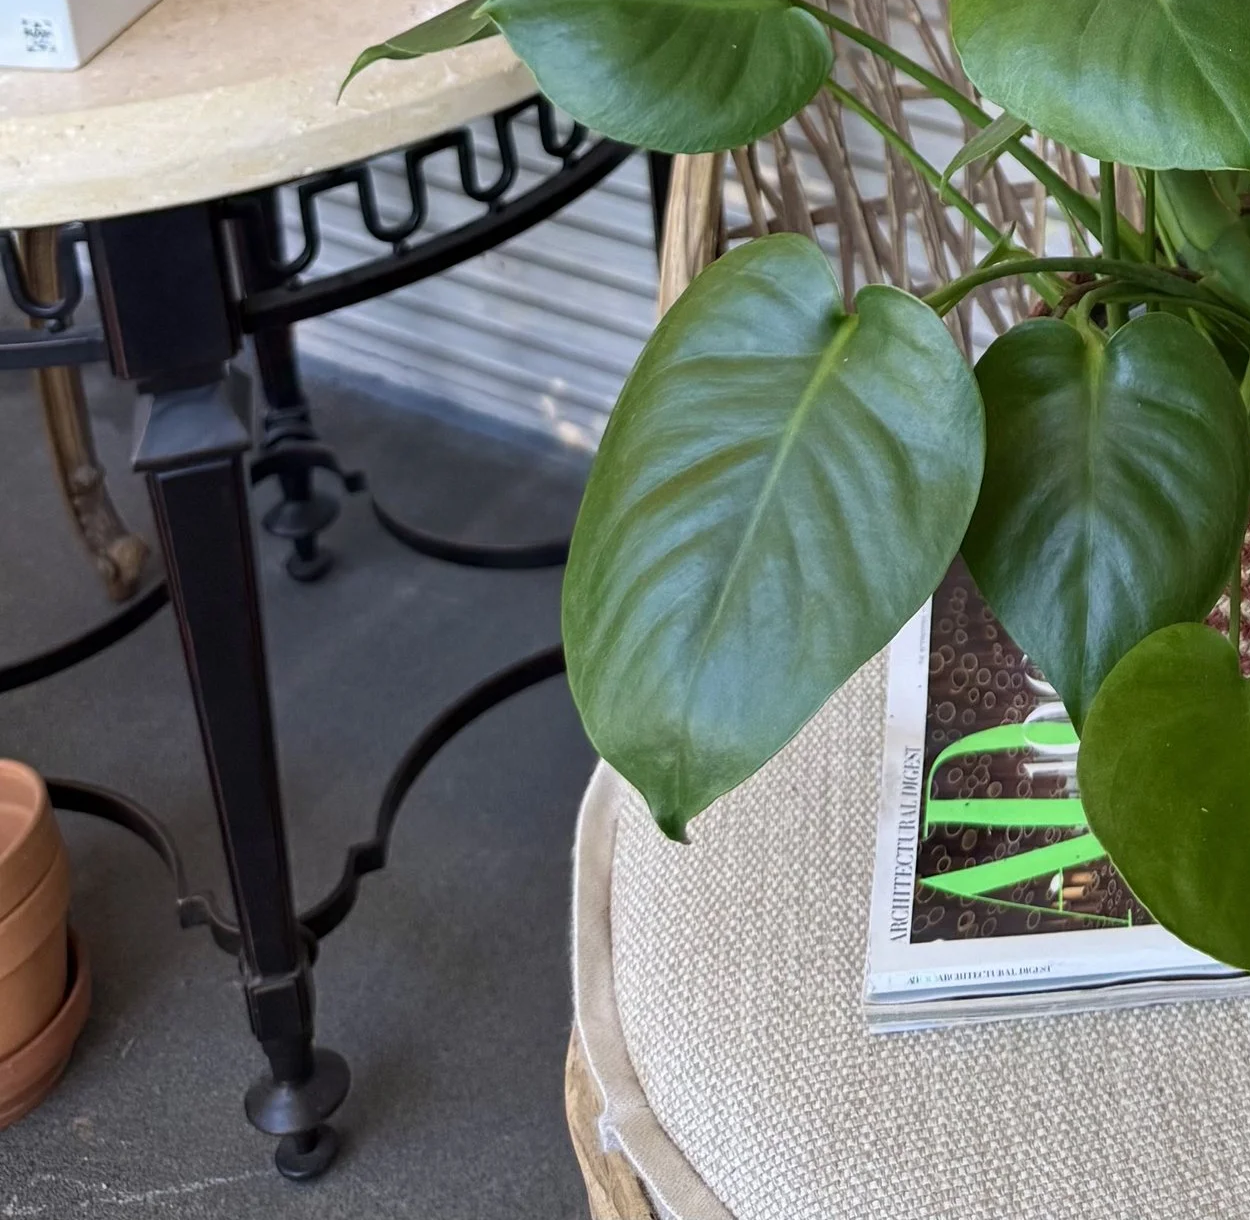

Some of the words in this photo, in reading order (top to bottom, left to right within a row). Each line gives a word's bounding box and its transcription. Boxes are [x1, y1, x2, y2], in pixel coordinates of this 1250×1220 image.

[901, 745, 922, 798] DIGEST
[889, 800, 917, 943] ARCHITECTURAL
[937, 967, 1017, 982] ARCHITECTURAL
[1018, 964, 1052, 975] DIGEST
